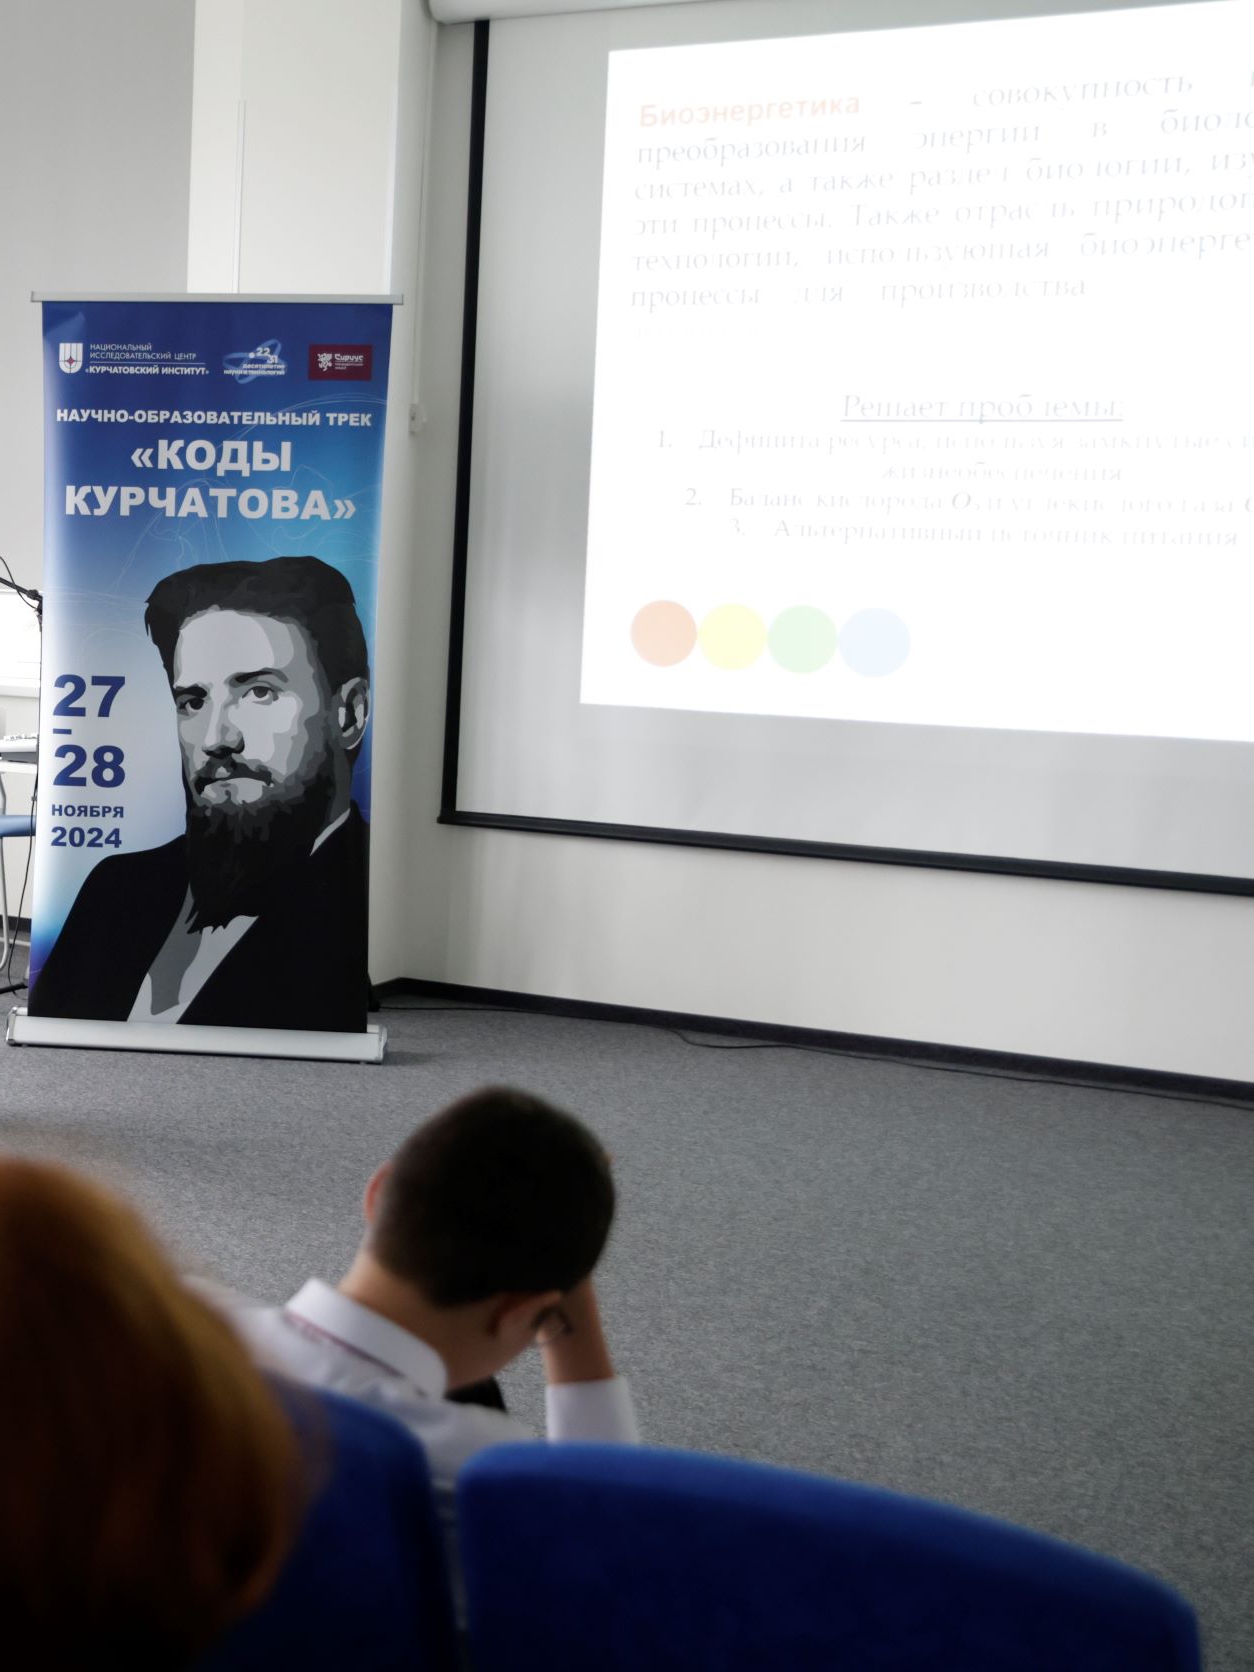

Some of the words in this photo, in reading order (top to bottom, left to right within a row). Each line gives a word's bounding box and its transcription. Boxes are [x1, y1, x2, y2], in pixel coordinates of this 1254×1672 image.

[639, 96, 860, 128] Биоэнергетика
[972, 76, 1194, 110] совокупность
[638, 136, 866, 170] преобразования
[913, 124, 1040, 154] энергии
[1092, 121, 1107, 138] в
[634, 177, 765, 201] системах,
[779, 177, 794, 193] а
[810, 172, 894, 192] также
[1026, 156, 1193, 181] биологии,
[634, 217, 678, 237] эти
[850, 202, 940, 226] Также
[632, 250, 799, 271] технологии,
[1081, 231, 1254, 261] биоэнерге
[631, 288, 760, 314] процессы
[882, 279, 1087, 310] производства
[89, 342, 152, 351] НАЦИОНАЛЬНЫЙ
[89, 351, 172, 360] ИССЛЕДОВАТЕЛЬСКИЙ
[174, 353, 197, 361] ЦЕНТР
[56, 408, 321, 427] НАУЧНО-ОБРАЗОВАТЕЛЬНЫЙ
[326, 412, 373, 427] ТРЕК
[842, 394, 946, 419] Решает
[657, 429, 673, 448] 1.
[131, 439, 292, 477] «КОДЫ
[65, 485, 357, 520] КУРЧАТОВА»
[685, 488, 703, 506] 2.
[729, 518, 746, 536] 3.
[53, 674, 126, 717] 27
[53, 744, 126, 788] 28
[51, 804, 124, 818] НОЯБРЯ
[51, 826, 122, 848] 2024
